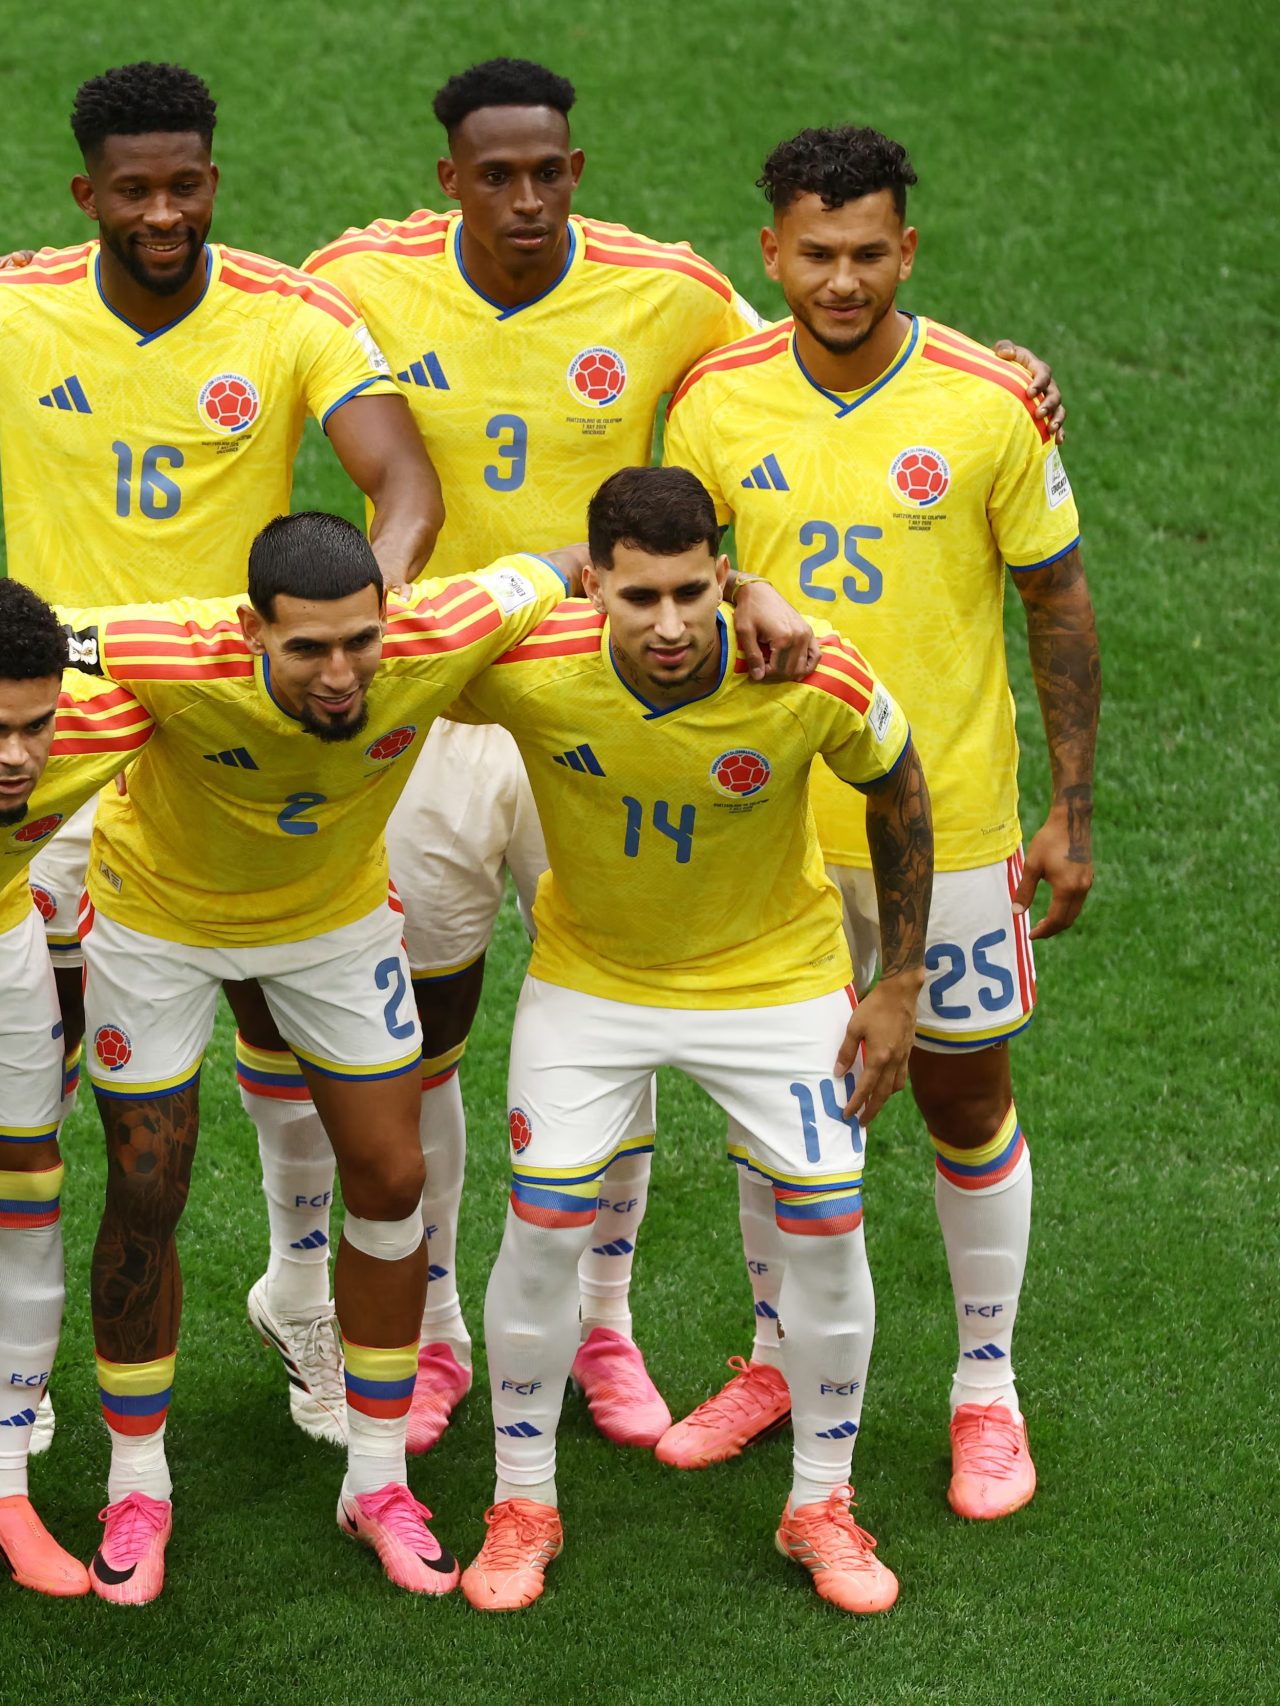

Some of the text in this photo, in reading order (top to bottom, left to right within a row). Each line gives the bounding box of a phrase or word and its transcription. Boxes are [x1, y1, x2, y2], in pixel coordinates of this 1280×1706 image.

[483, 415, 528, 492] 3
[111, 440, 184, 520] 16
[799, 520, 883, 605] 25
[276, 792, 328, 836] 2
[622, 796, 696, 863] 14
[925, 928, 1014, 1019] 25
[374, 956, 416, 1040] 2
[790, 1072, 863, 1163] 14
[295, 1192, 331, 1207] FCF
[598, 1198, 639, 1213] FCF
[748, 1261, 769, 1276] CF
[964, 1304, 1004, 1318] FCF
[10, 1372, 49, 1386] FCF
[502, 1380, 542, 1395] FCF
[820, 1381, 861, 1396] FCF
